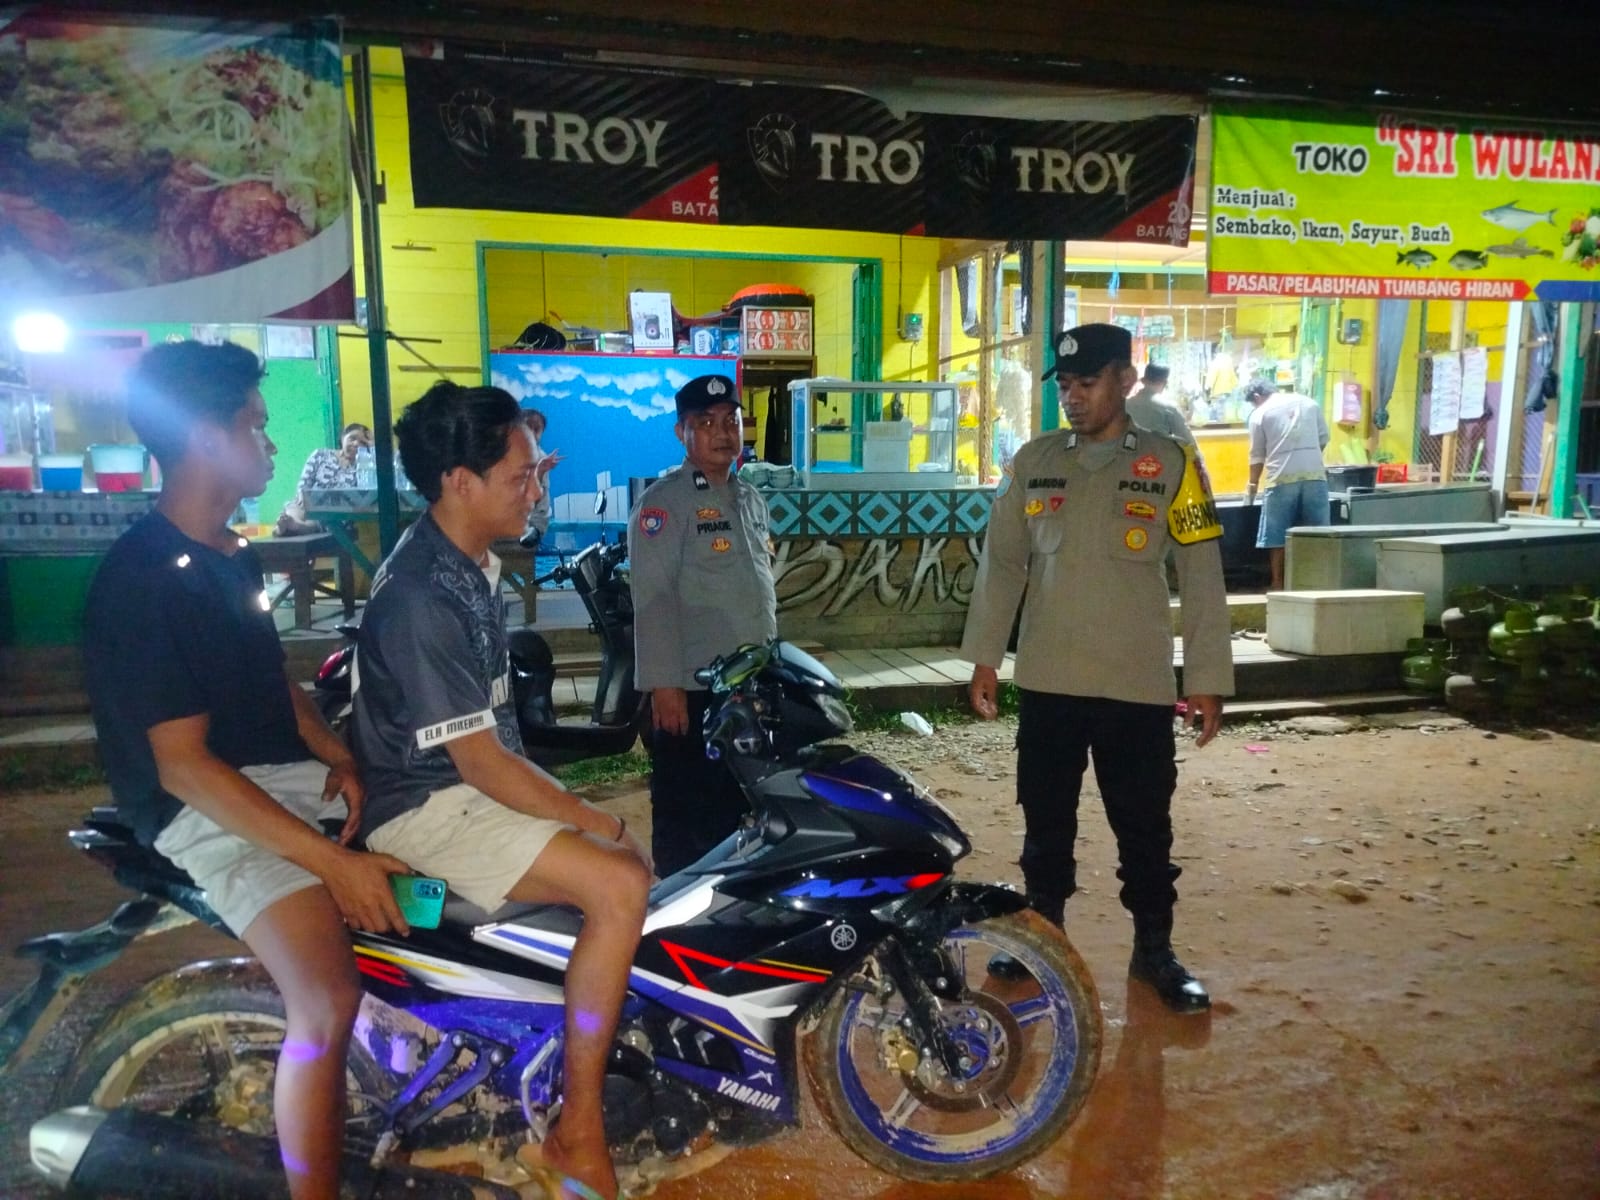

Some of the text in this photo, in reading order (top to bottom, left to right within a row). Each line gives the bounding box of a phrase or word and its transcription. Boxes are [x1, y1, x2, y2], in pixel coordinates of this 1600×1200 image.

[513, 109, 668, 168] TROY
[1295, 145, 1367, 173] TOKO
[1473, 128, 1600, 182] WULAN
[1011, 147, 1136, 196] TROY
[1168, 202, 1190, 225] 20
[1215, 216, 1450, 244] Sembako, Ikan, Sayur, Buah
[1226, 274, 1514, 298] PASAR/PELABUHAN TUMBANG HIRAN
[1118, 480, 1166, 496] POLRI
[717, 1076, 781, 1112] YAMAHA
